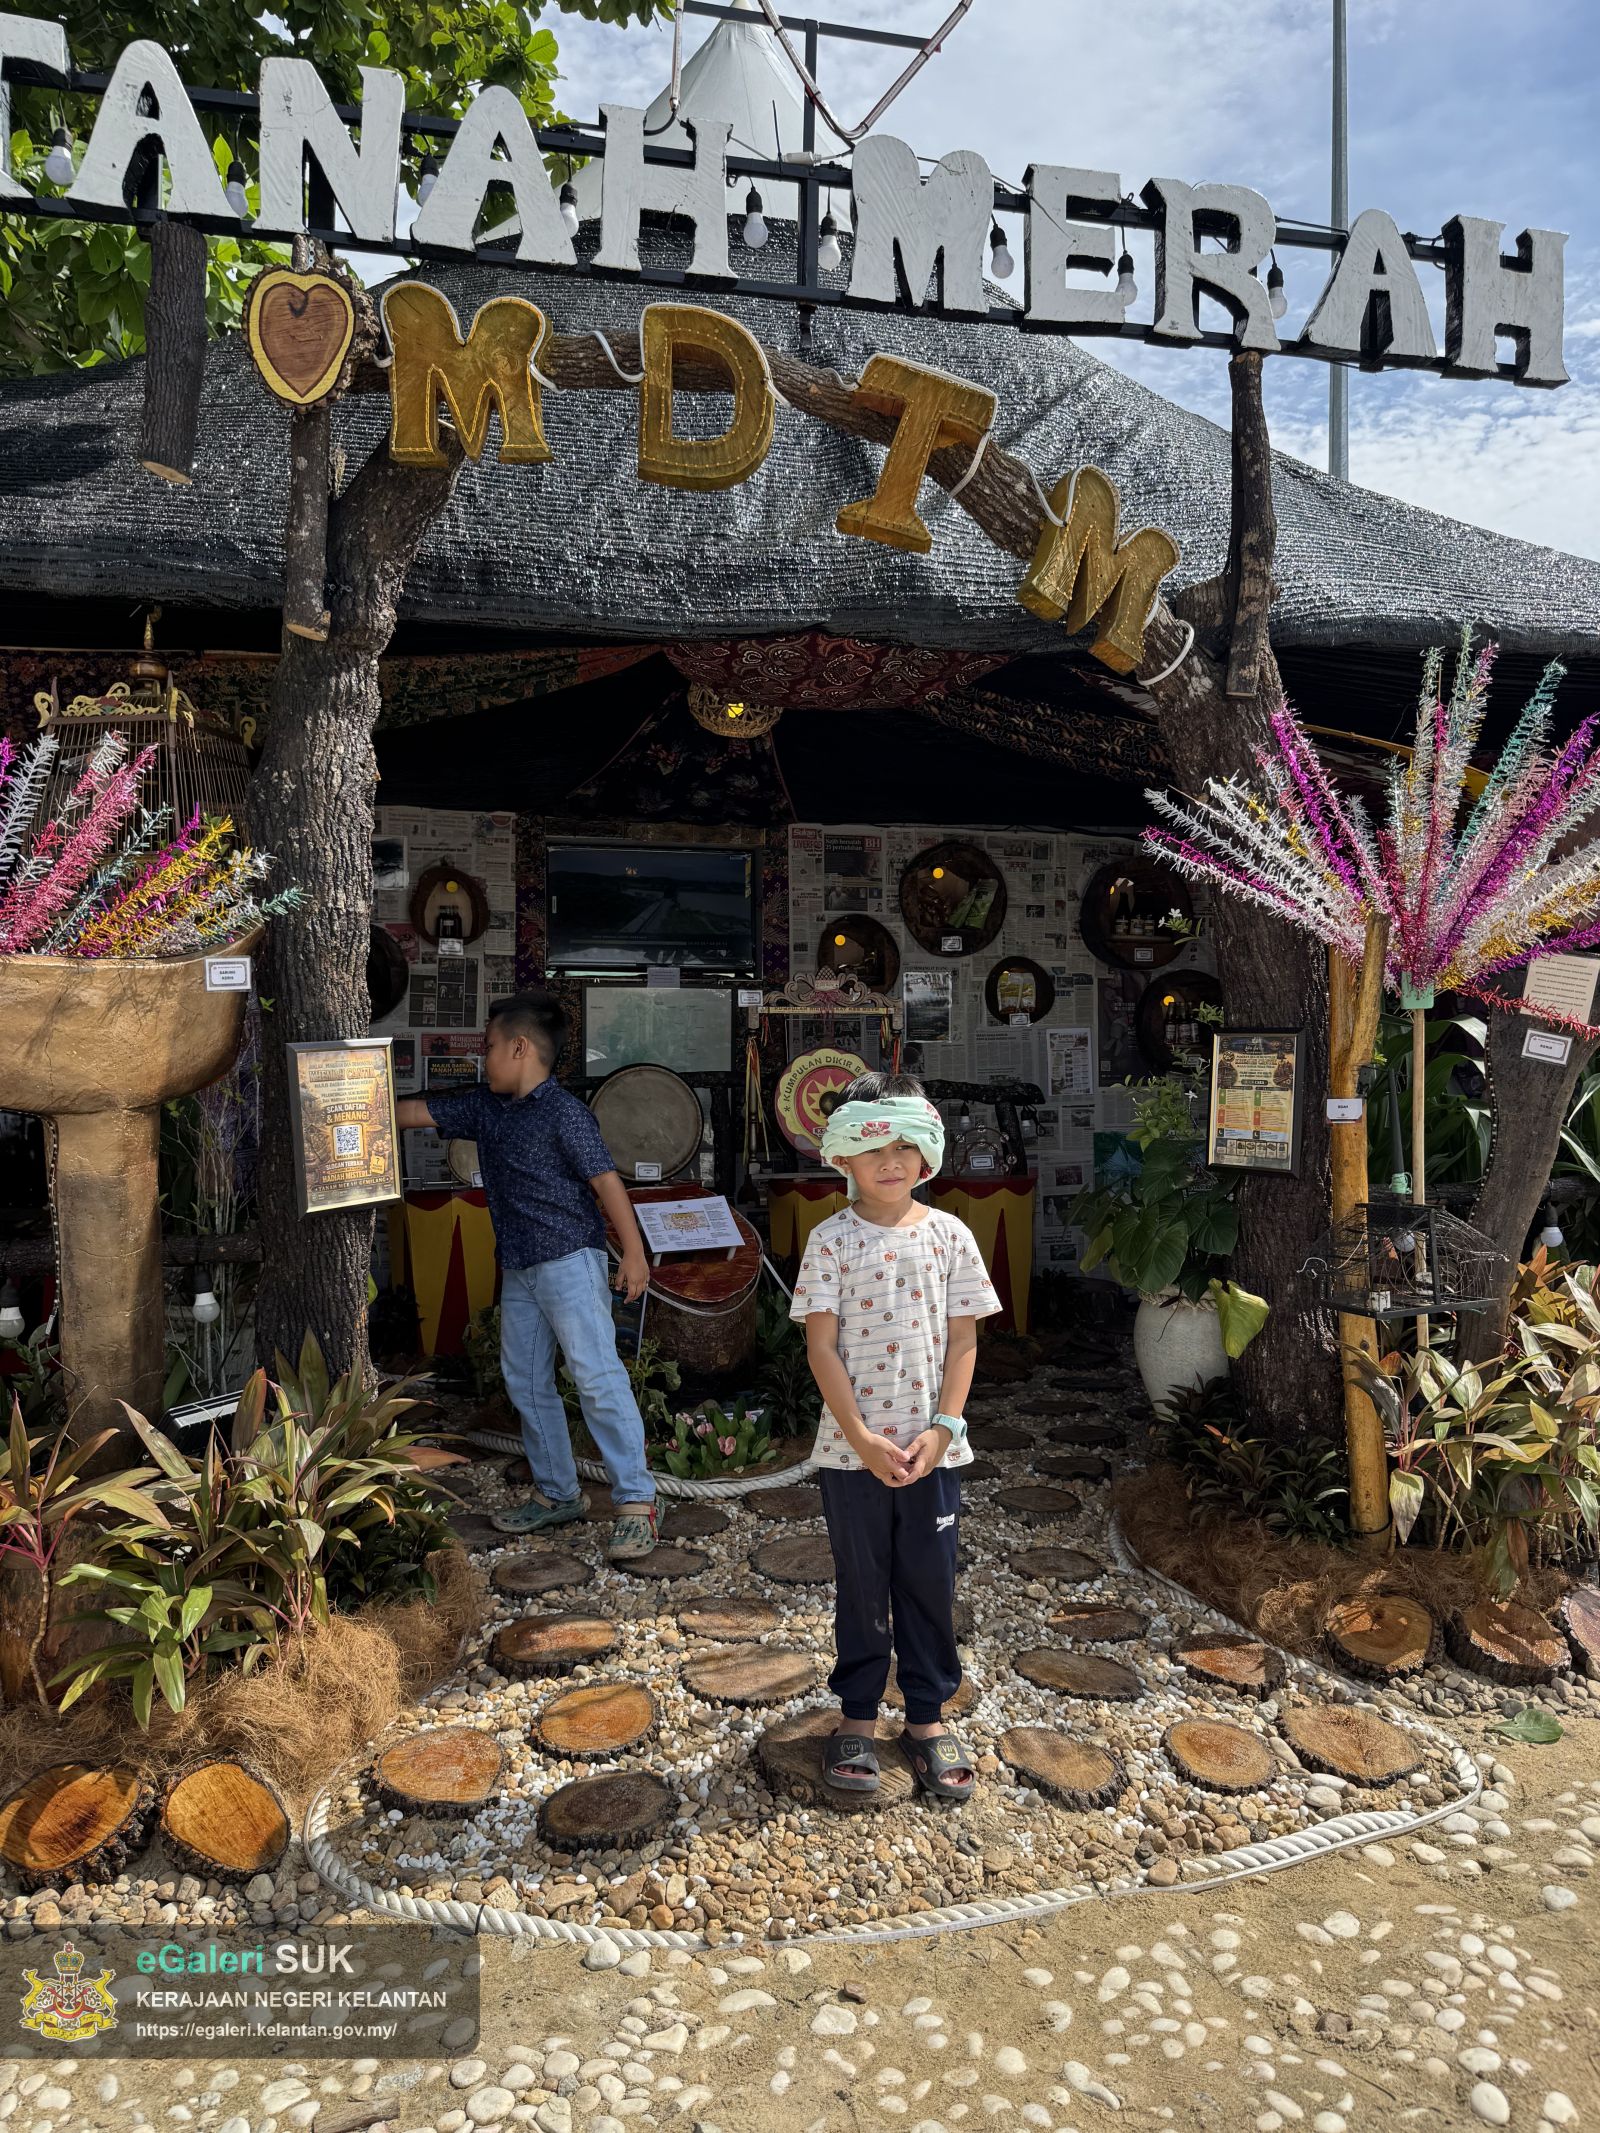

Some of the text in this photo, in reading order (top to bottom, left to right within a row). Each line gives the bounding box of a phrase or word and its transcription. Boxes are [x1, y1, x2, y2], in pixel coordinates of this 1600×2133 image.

[846, 134, 1571, 389] MERAH
[784, 1056, 853, 1102] KUMPULAN DIKIR
[326, 1111, 370, 1123] & MENANG!
[344, 1103, 366, 1111] DAFTAR
